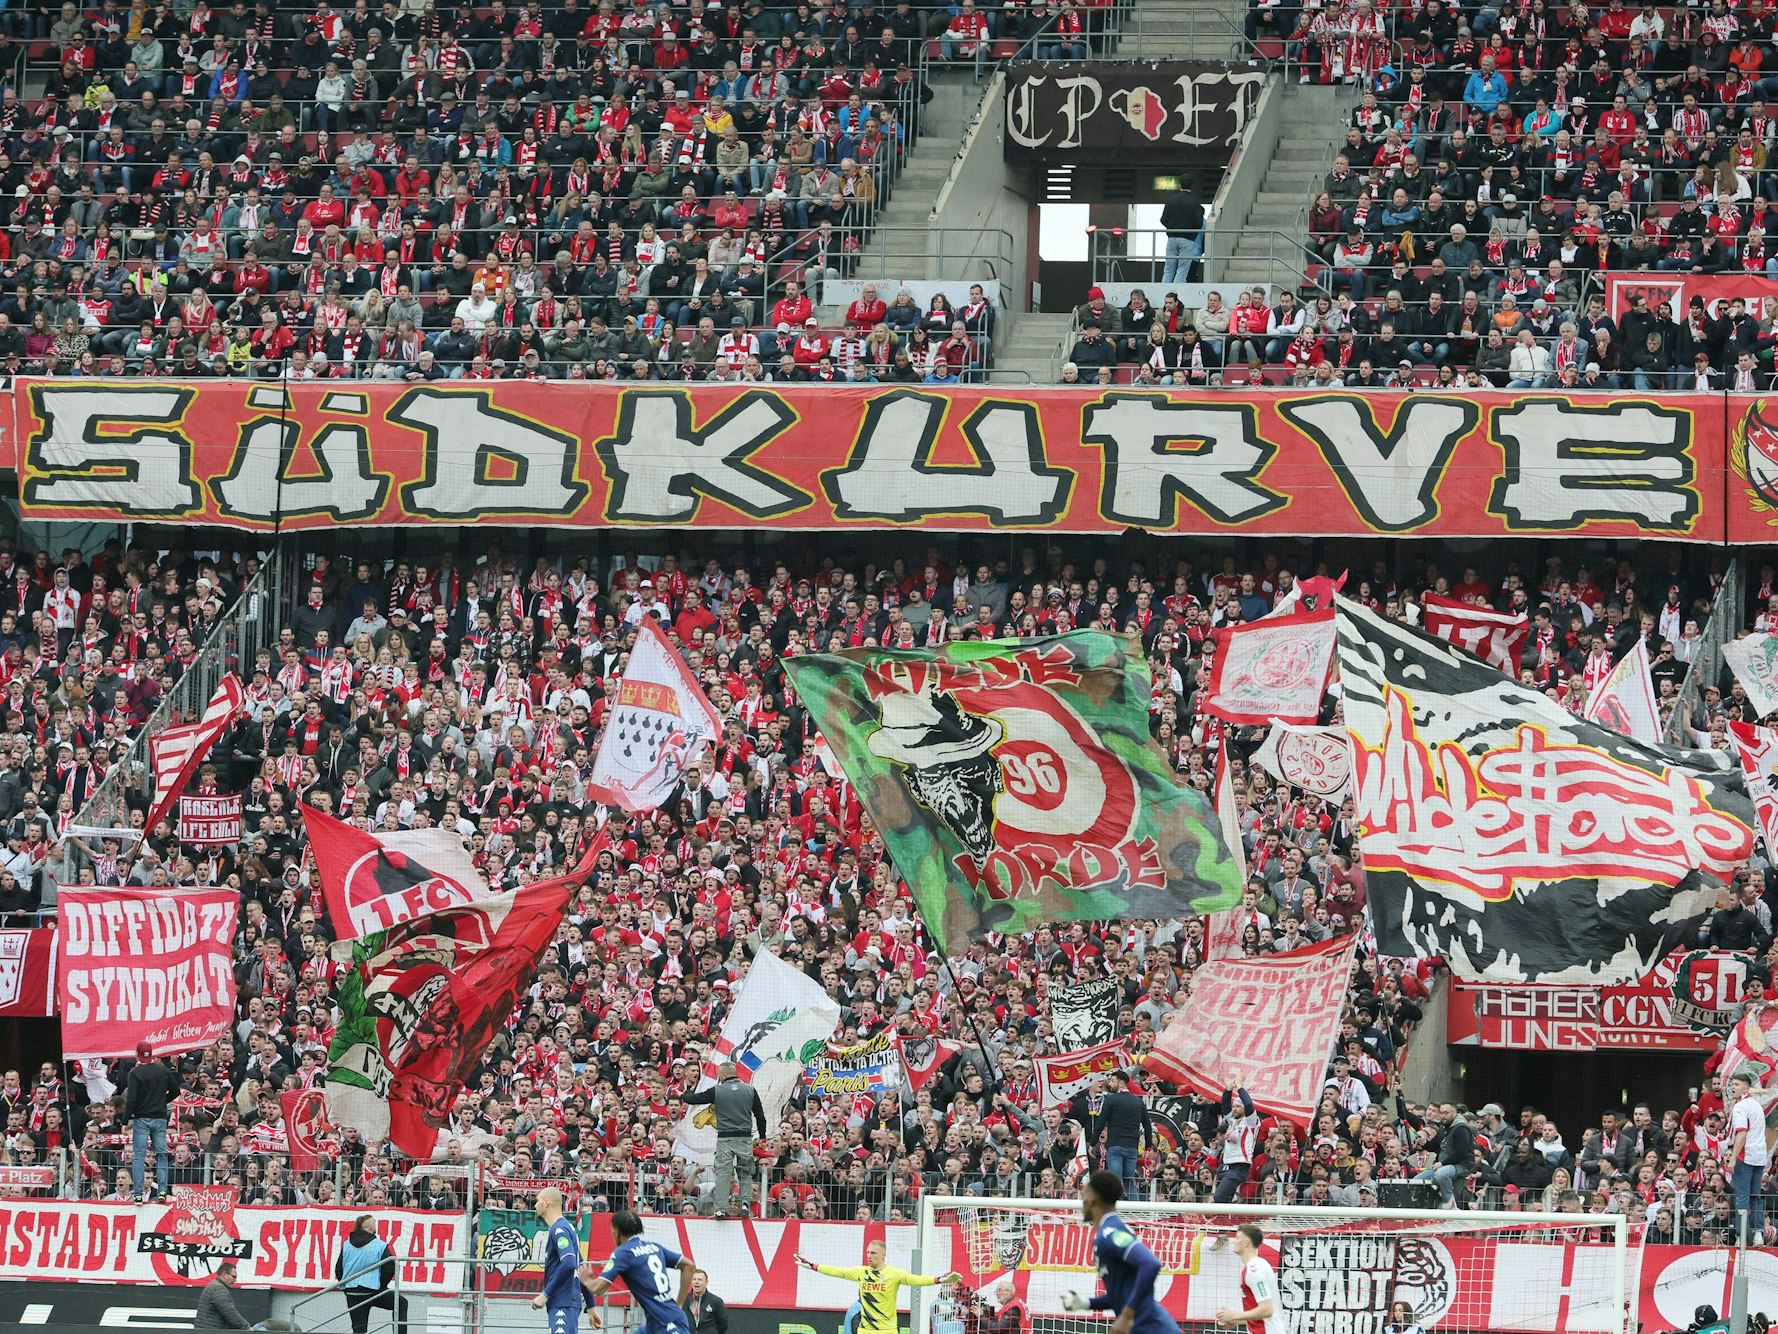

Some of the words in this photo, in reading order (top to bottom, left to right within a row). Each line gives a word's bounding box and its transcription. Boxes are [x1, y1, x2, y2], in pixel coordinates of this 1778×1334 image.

[87, 308, 108, 316] REWE
[23, 385, 1703, 533] SÜDKURVE
[862, 643, 1082, 702] WILDE
[999, 752, 1061, 795] 96
[182, 799, 240, 817] RASCALS
[210, 820, 239, 838] KÖLN
[952, 835, 1168, 901] HORDE
[64, 898, 235, 957] DIFFIDATI
[66, 953, 232, 1024] SYNDIKAT
[1693, 971, 1741, 1003] 51
[172, 1021, 202, 1040] bleiben
[1483, 1020, 1597, 1049] JUNGS
[809, 1069, 869, 1095] Paris
[9, 1170, 43, 1184] Platz
[196, 1242, 247, 1256] 2007
[1284, 1236, 1395, 1269] SEKTION
[647, 1254, 670, 1294] 8
[862, 1282, 886, 1292] REWE
[1281, 1269, 1393, 1310] STADT
